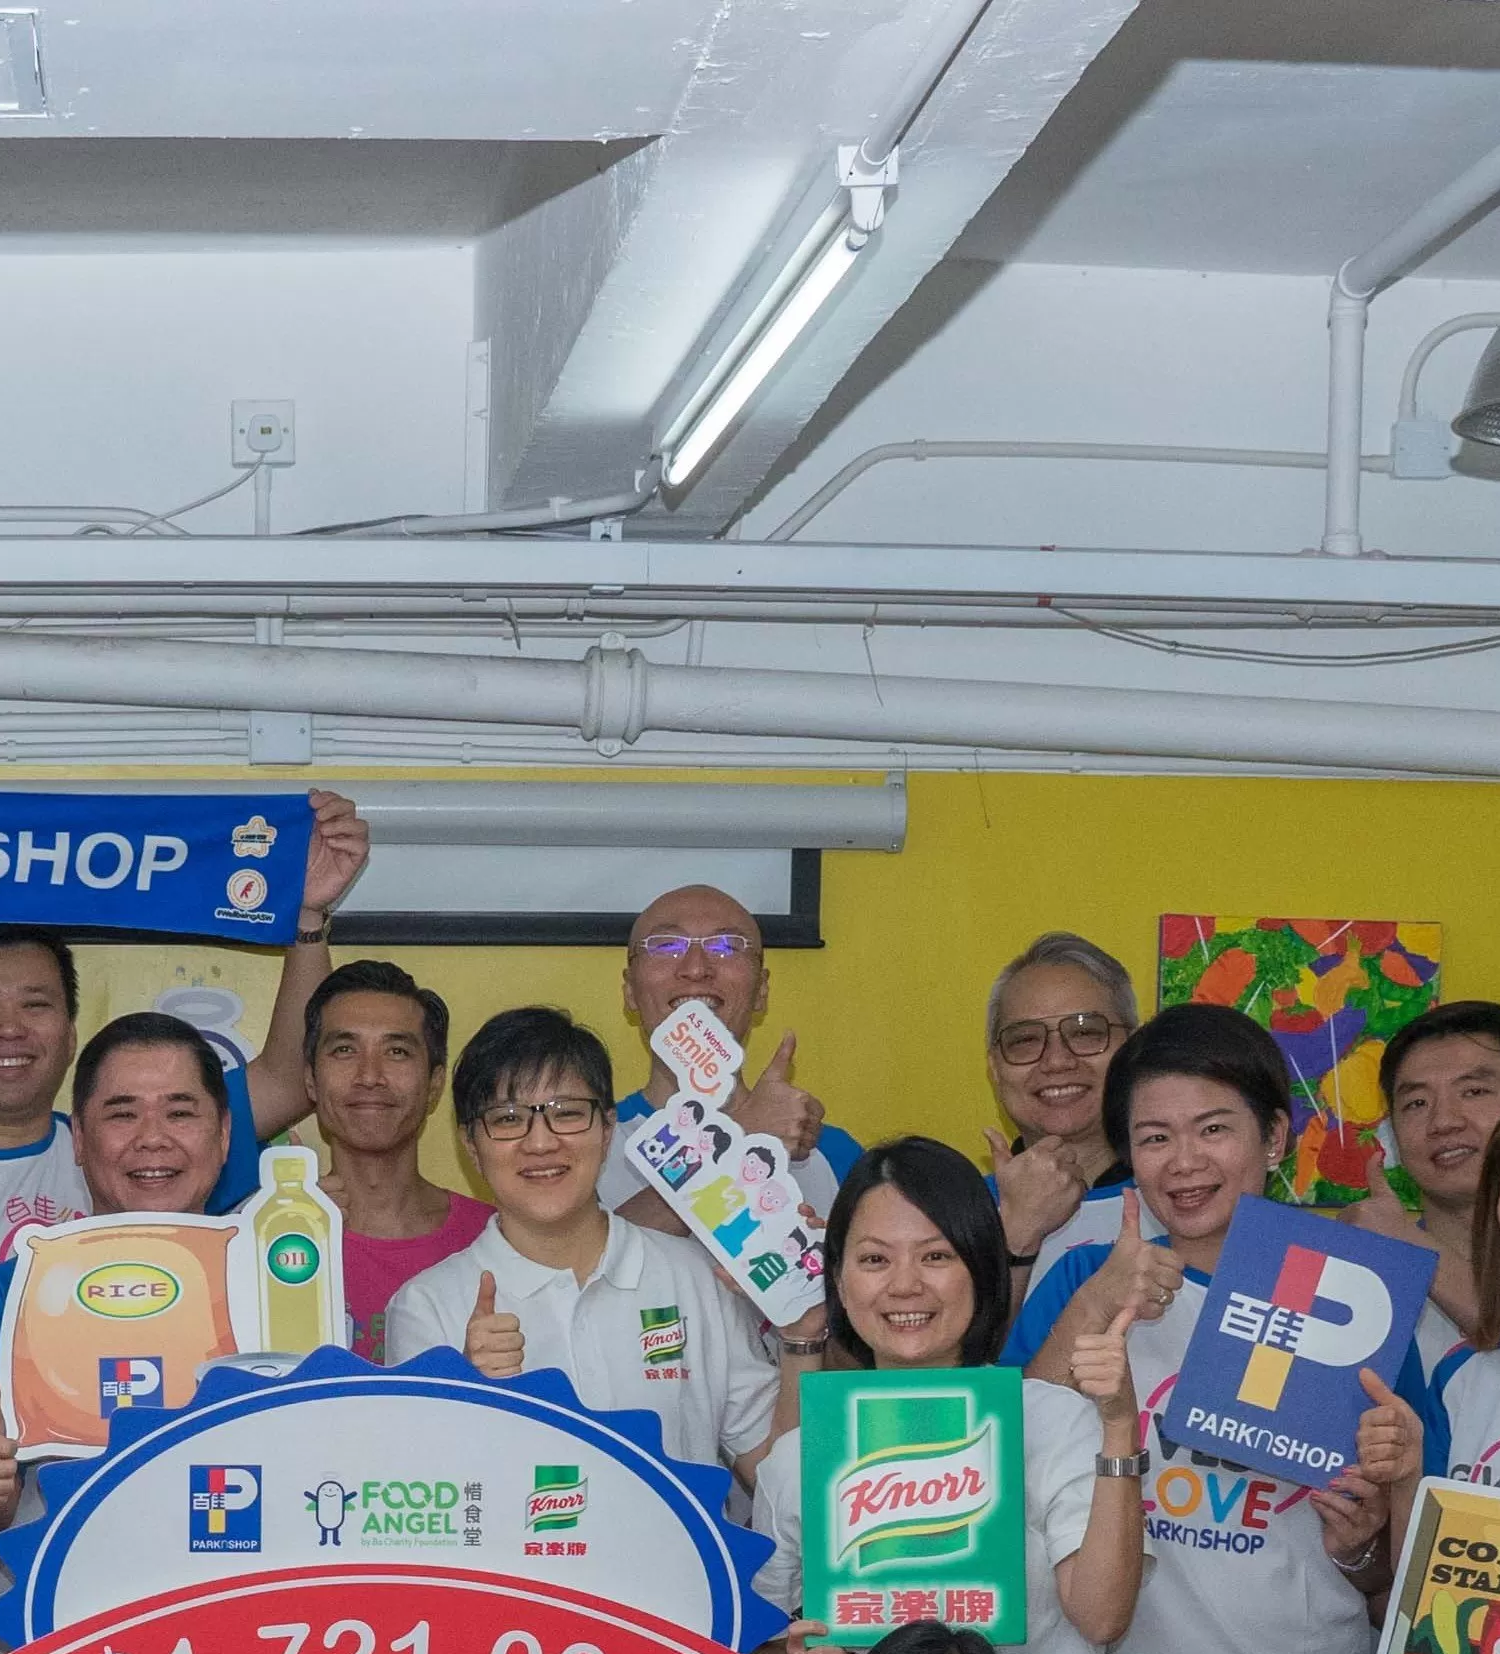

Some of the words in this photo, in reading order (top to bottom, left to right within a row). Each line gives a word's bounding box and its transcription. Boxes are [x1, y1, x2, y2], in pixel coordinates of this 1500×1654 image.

[275, 1252, 313, 1267] OIL
[86, 1281, 169, 1300] RICE
[361, 1480, 460, 1510] FOOD
[528, 1494, 586, 1517] Knorr
[839, 1465, 986, 1527] Knorr
[1143, 1466, 1277, 1530] OVE
[361, 1512, 459, 1535] ANGEL
[463, 1481, 483, 1547] 惜食堂
